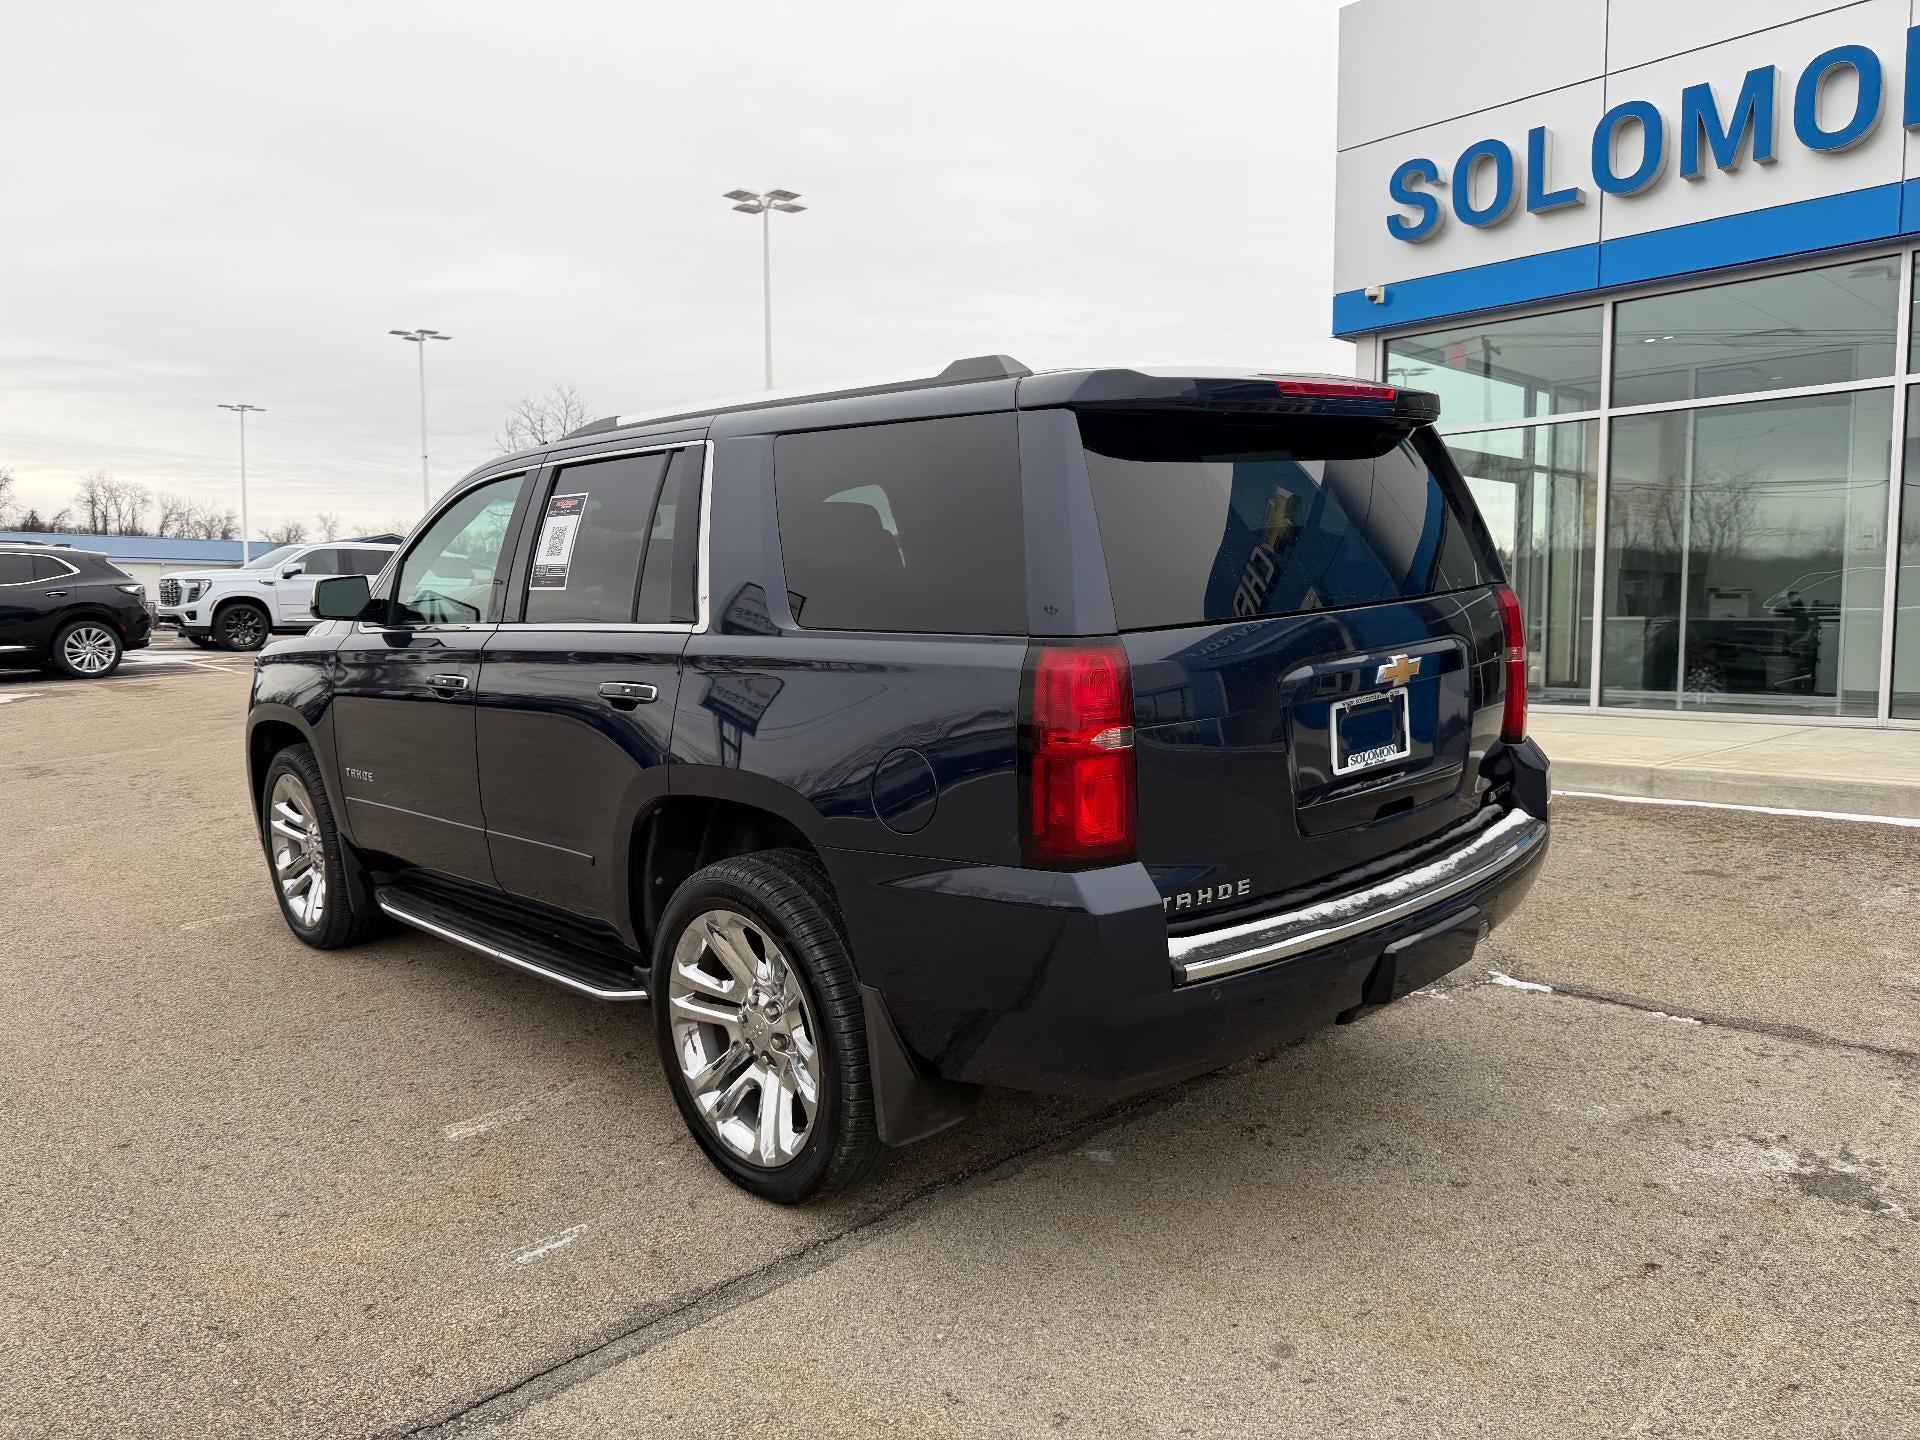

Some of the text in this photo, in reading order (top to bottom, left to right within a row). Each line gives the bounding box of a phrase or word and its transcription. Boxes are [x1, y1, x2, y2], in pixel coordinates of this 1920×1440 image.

[1350, 745, 1396, 766] SOLOMON
[345, 767, 374, 782] TAHOE
[1162, 878, 1251, 913] TAHOE
